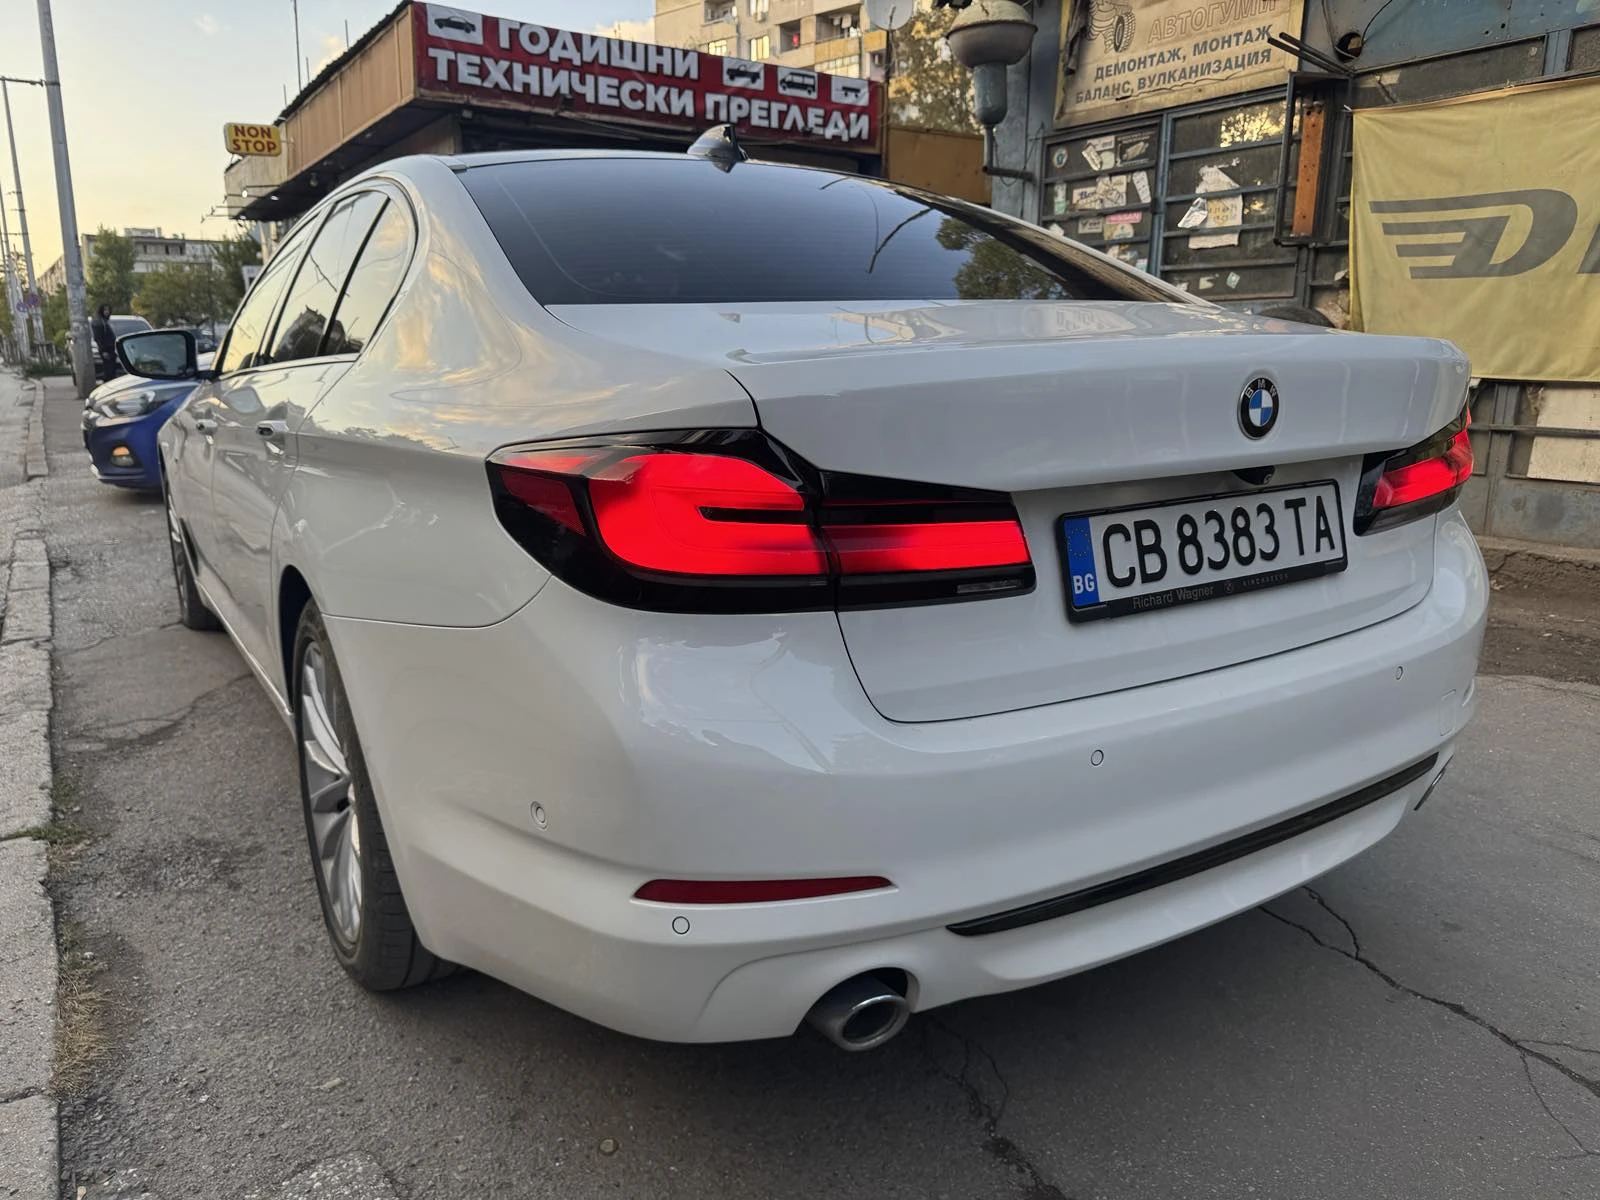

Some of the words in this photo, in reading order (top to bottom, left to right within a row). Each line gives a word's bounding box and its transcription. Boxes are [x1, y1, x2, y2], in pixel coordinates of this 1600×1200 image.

[497, 19, 699, 80] ГОДИШНИ
[1094, 47, 1187, 83] ДЕМОНТАЖ,
[1192, 24, 1273, 57] МОНТАЖ
[428, 48, 695, 118] ТЕХНИЧЕСКИ
[704, 93, 870, 142] ПРЕГЛЕДИ
[1075, 81, 1134, 105] БАЛАНС,
[1137, 48, 1272, 91] ВУЛКАНИЗАЦИЯ
[232, 138, 277, 152] STOP
[233, 125, 272, 139] NON
[1245, 379, 1277, 398] BMW
[1102, 519, 1168, 588] CB
[1176, 502, 1280, 576] 8383
[1284, 495, 1336, 556] TA
[1072, 573, 1095, 595] BG
[1132, 591, 1174, 609] Richard
[1176, 585, 1215, 602] Wagner
